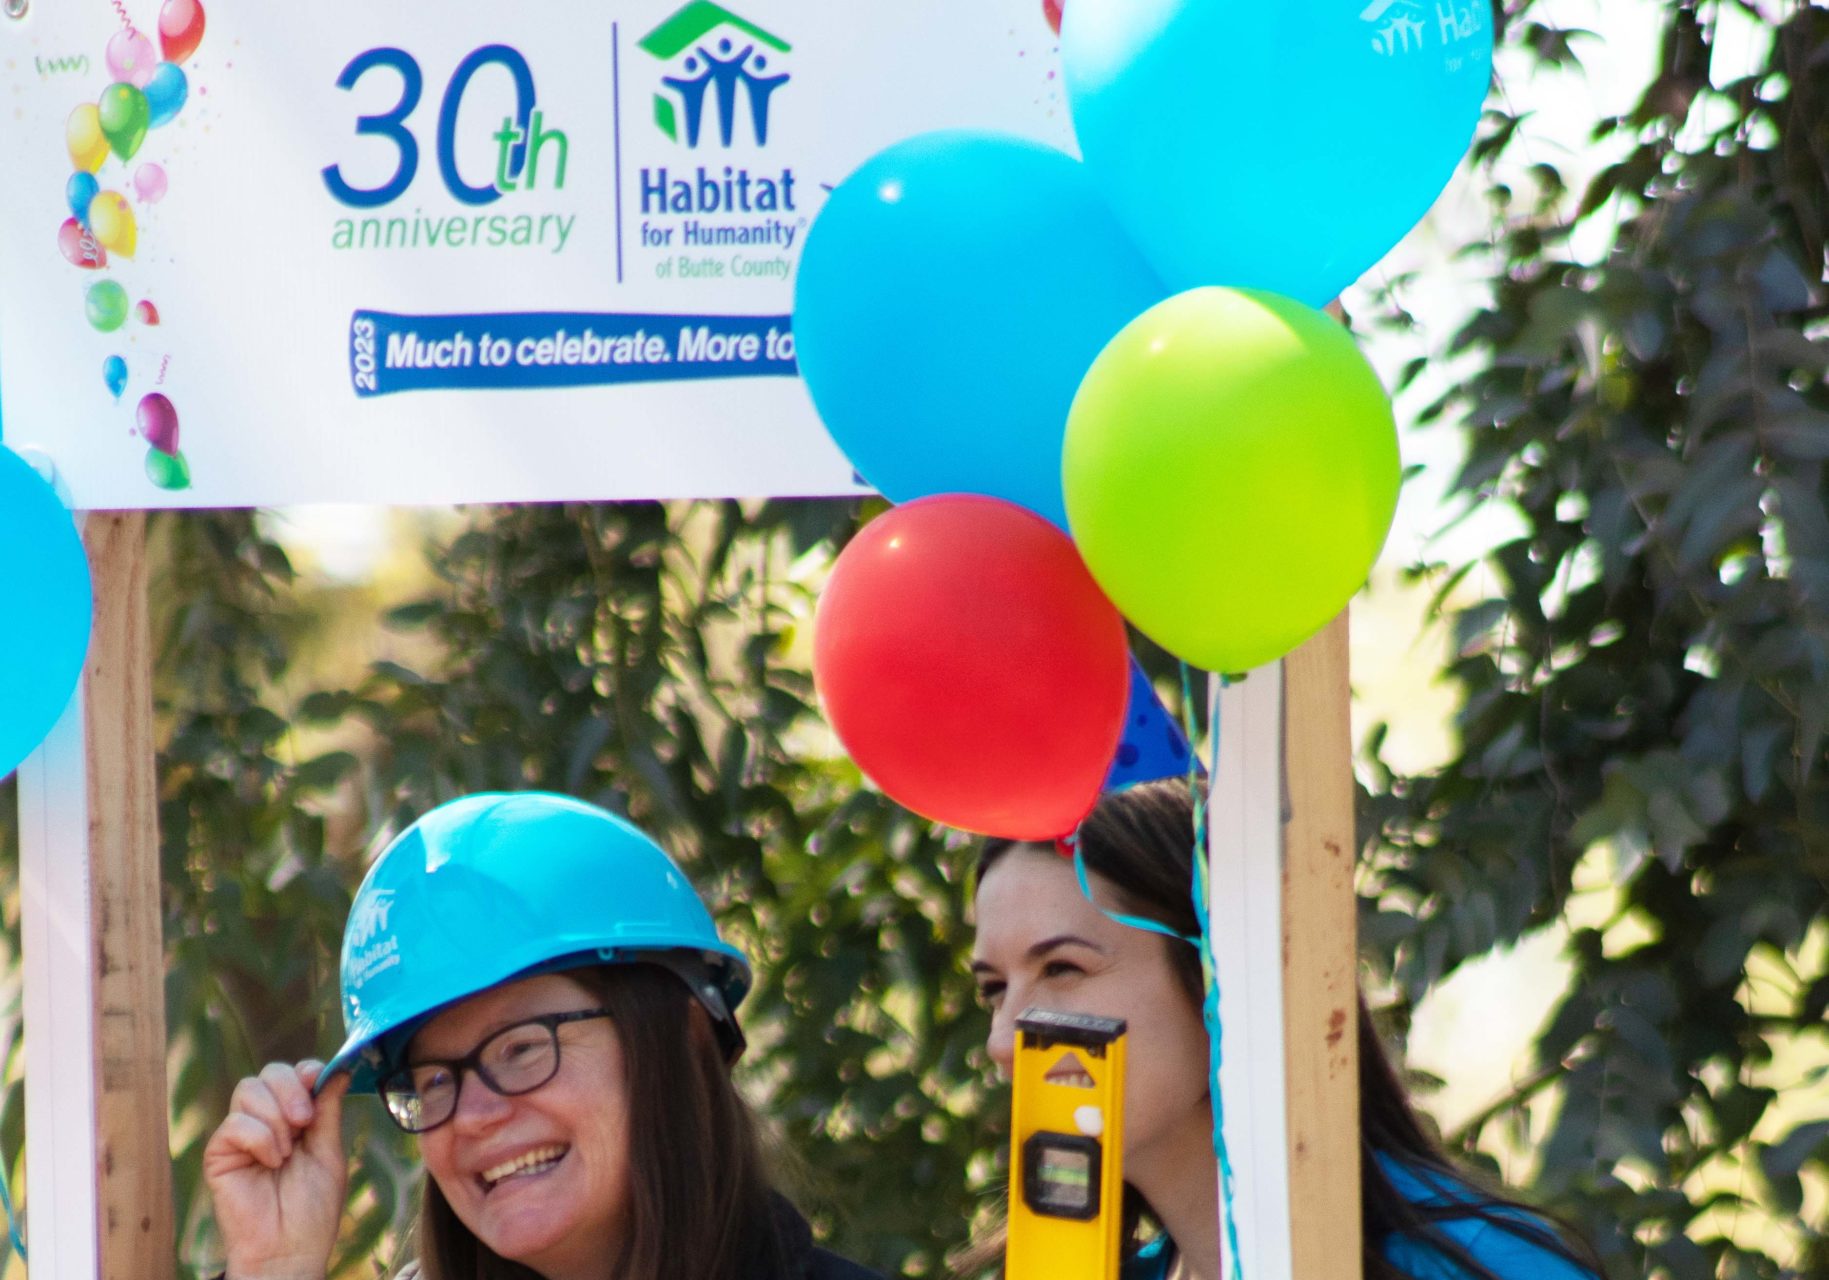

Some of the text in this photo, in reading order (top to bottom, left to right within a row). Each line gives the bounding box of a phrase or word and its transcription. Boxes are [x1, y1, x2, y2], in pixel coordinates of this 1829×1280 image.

[639, 166, 796, 214] Habitat
[331, 209, 576, 252] anniversary
[641, 218, 796, 250] for Humanity
[655, 253, 792, 281] of Butte County
[353, 317, 376, 391] 2023
[385, 326, 796, 368] Much to celebrate. More to
